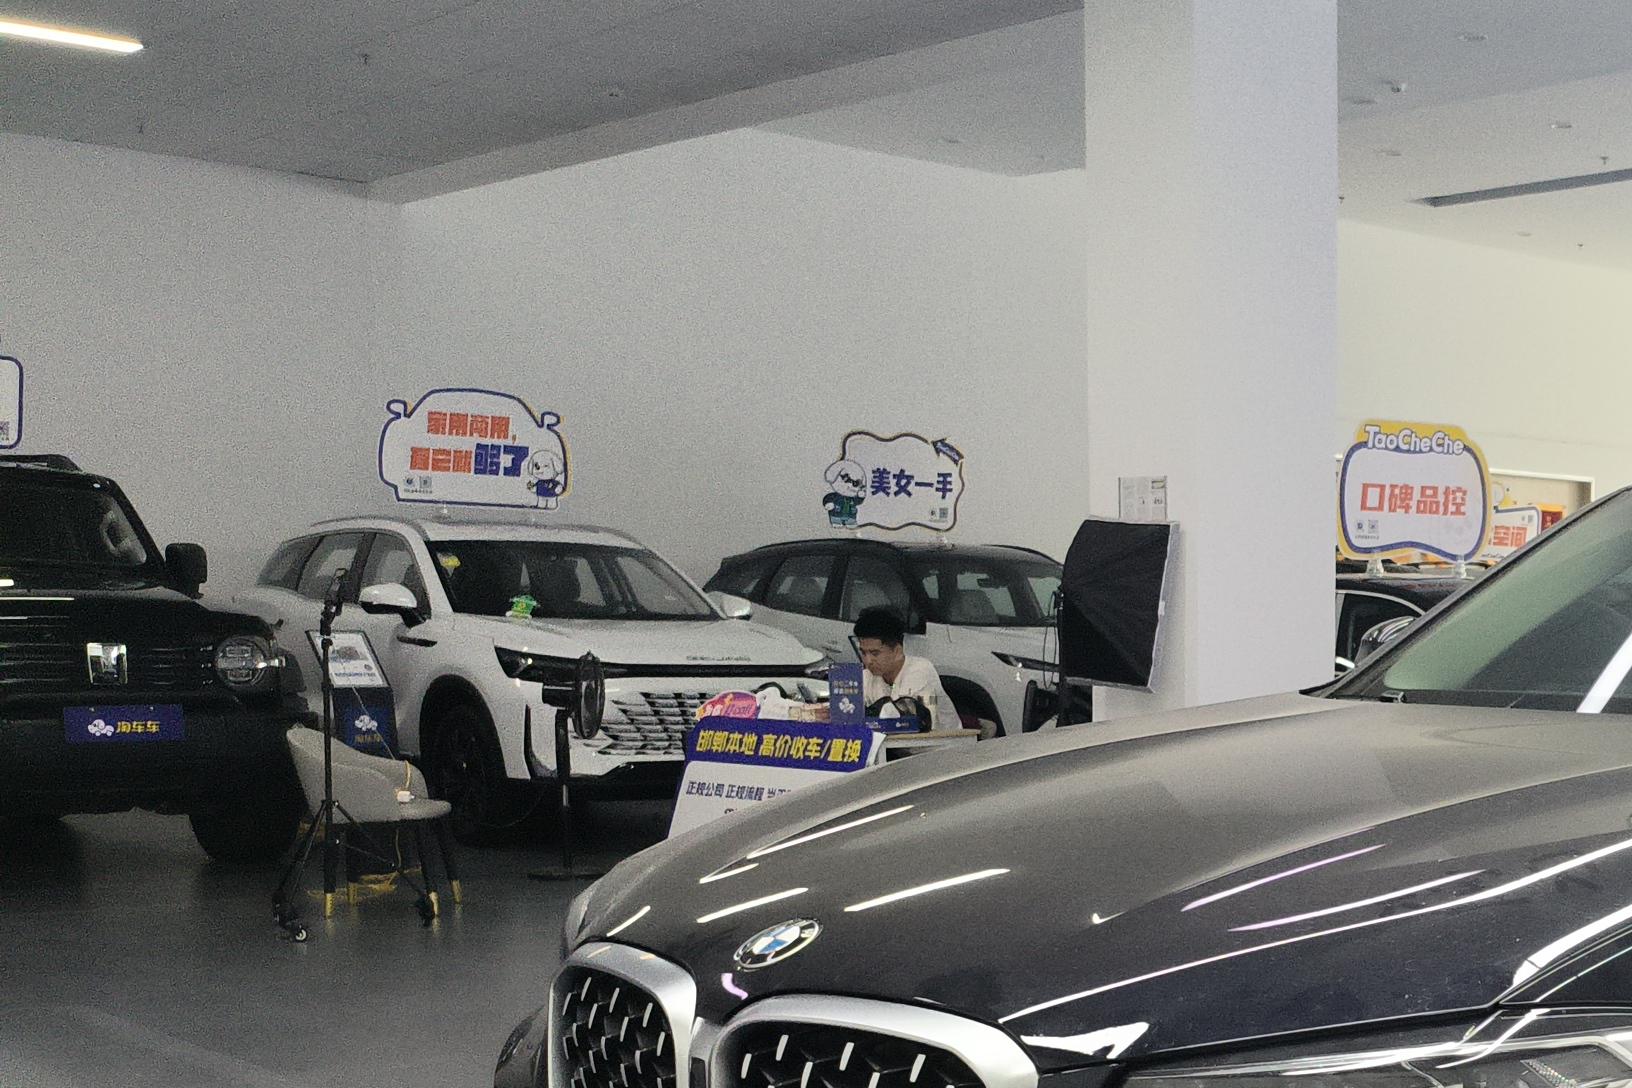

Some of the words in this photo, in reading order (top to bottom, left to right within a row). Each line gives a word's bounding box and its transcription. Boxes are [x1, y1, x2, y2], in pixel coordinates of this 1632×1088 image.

[1364, 425, 1465, 455] TaoCheChe
[870, 467, 953, 500] 美女一手
[1360, 482, 1468, 517] 口碑品控
[1488, 525, 1528, 548] 空间
[116, 720, 160, 734] 淘车车
[696, 729, 757, 756] 邯郸本地
[759, 733, 862, 763] 高价收车/置换
[686, 781, 725, 798] 正规公司
[725, 784, 765, 801] 正规流程
